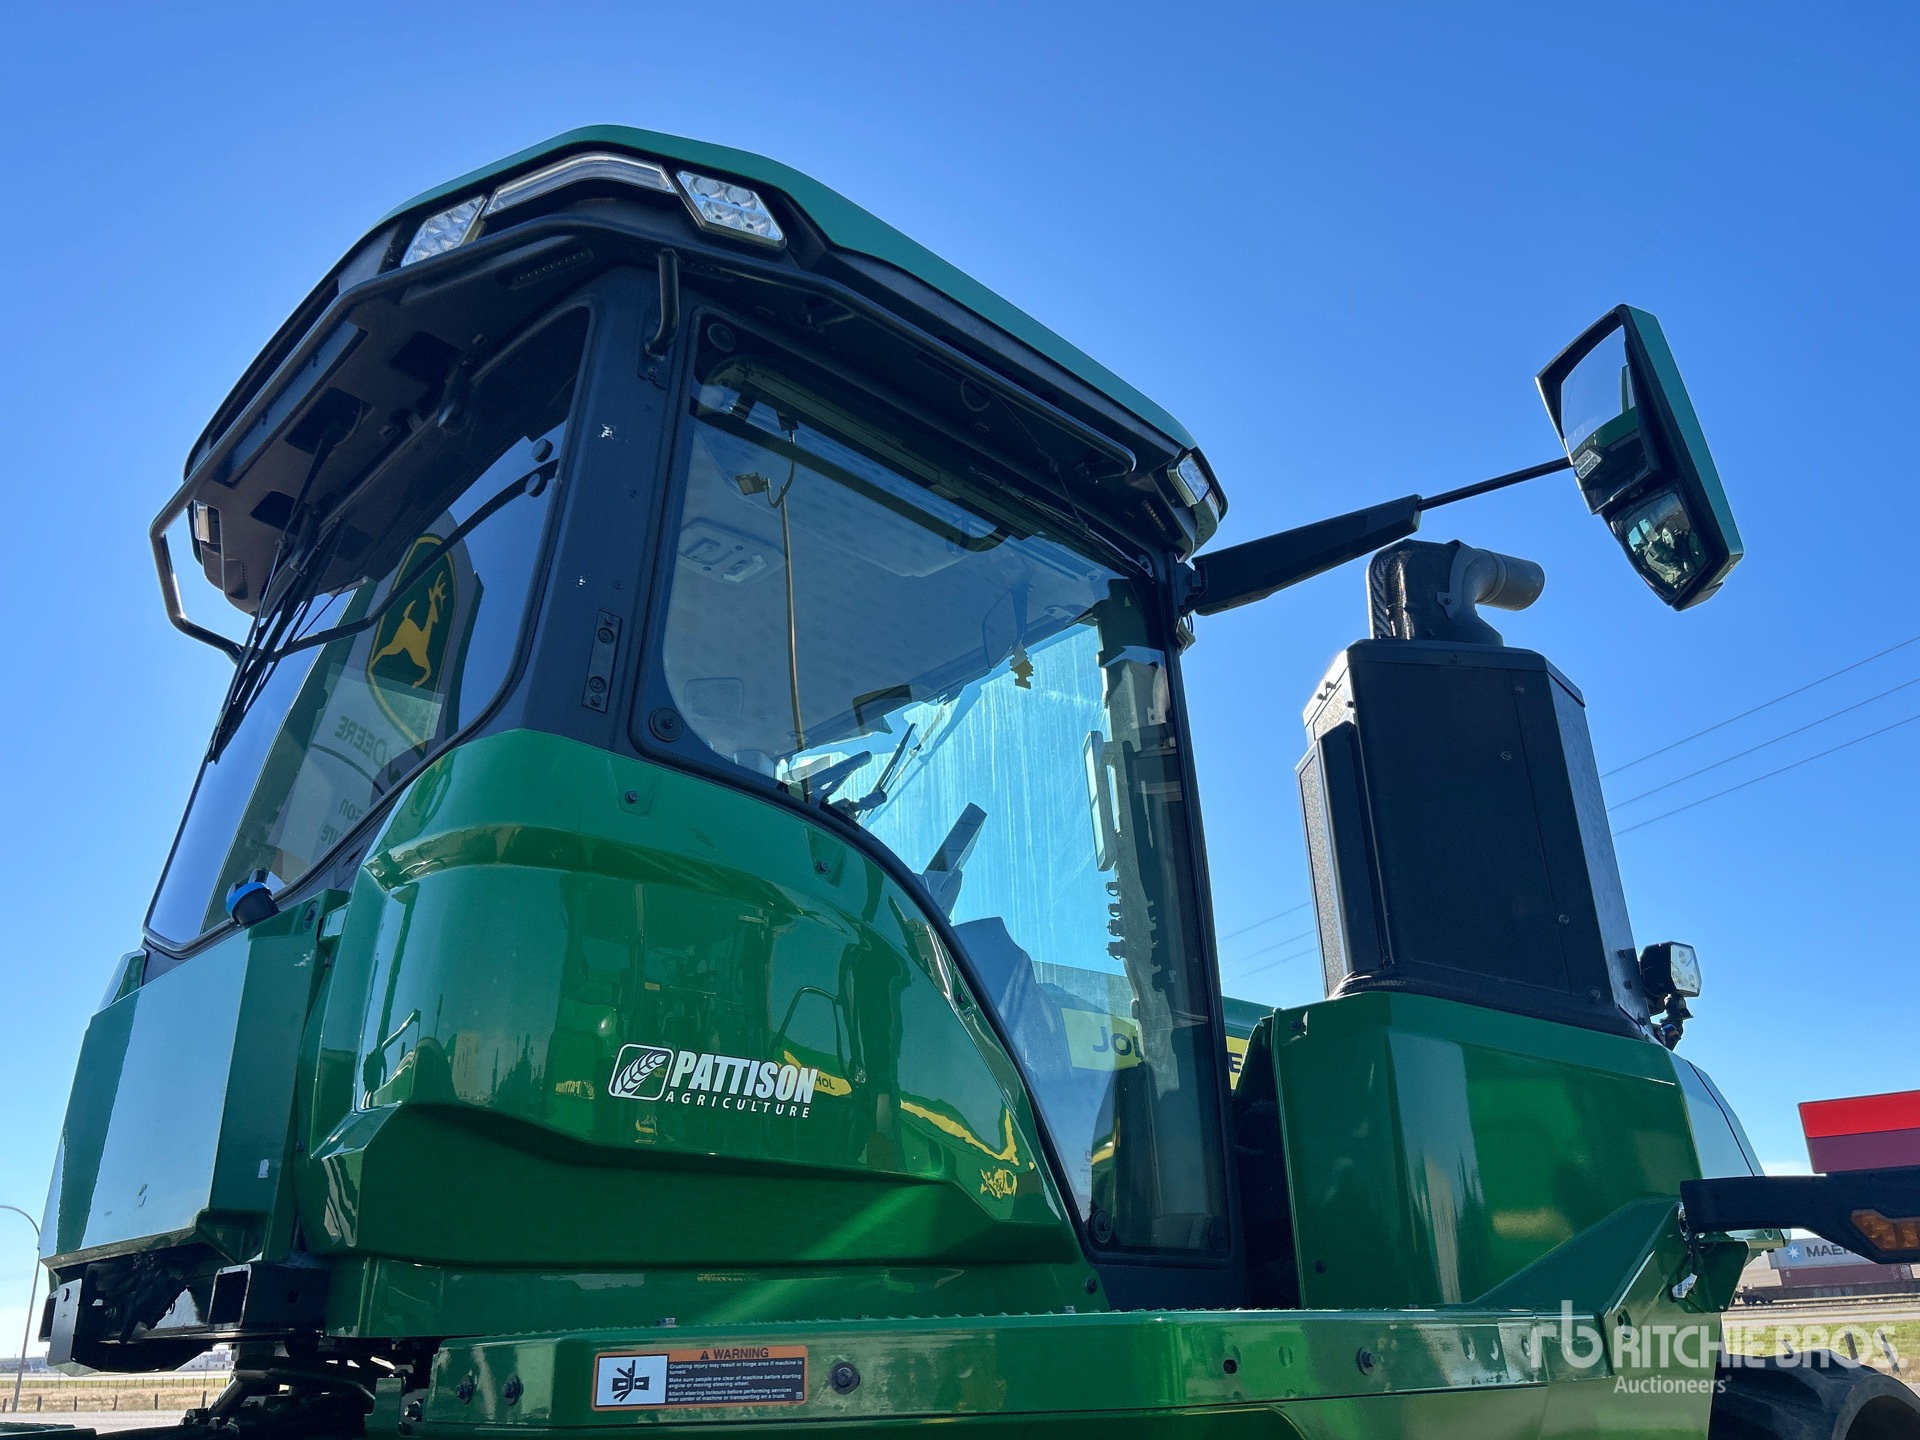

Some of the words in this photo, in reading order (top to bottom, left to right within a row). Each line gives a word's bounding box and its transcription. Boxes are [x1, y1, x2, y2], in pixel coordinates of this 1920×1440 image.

[669, 1050, 818, 1104] PATTISON
[665, 1091, 811, 1119] AGRICULTURE
[713, 1347, 769, 1360] WARNING
